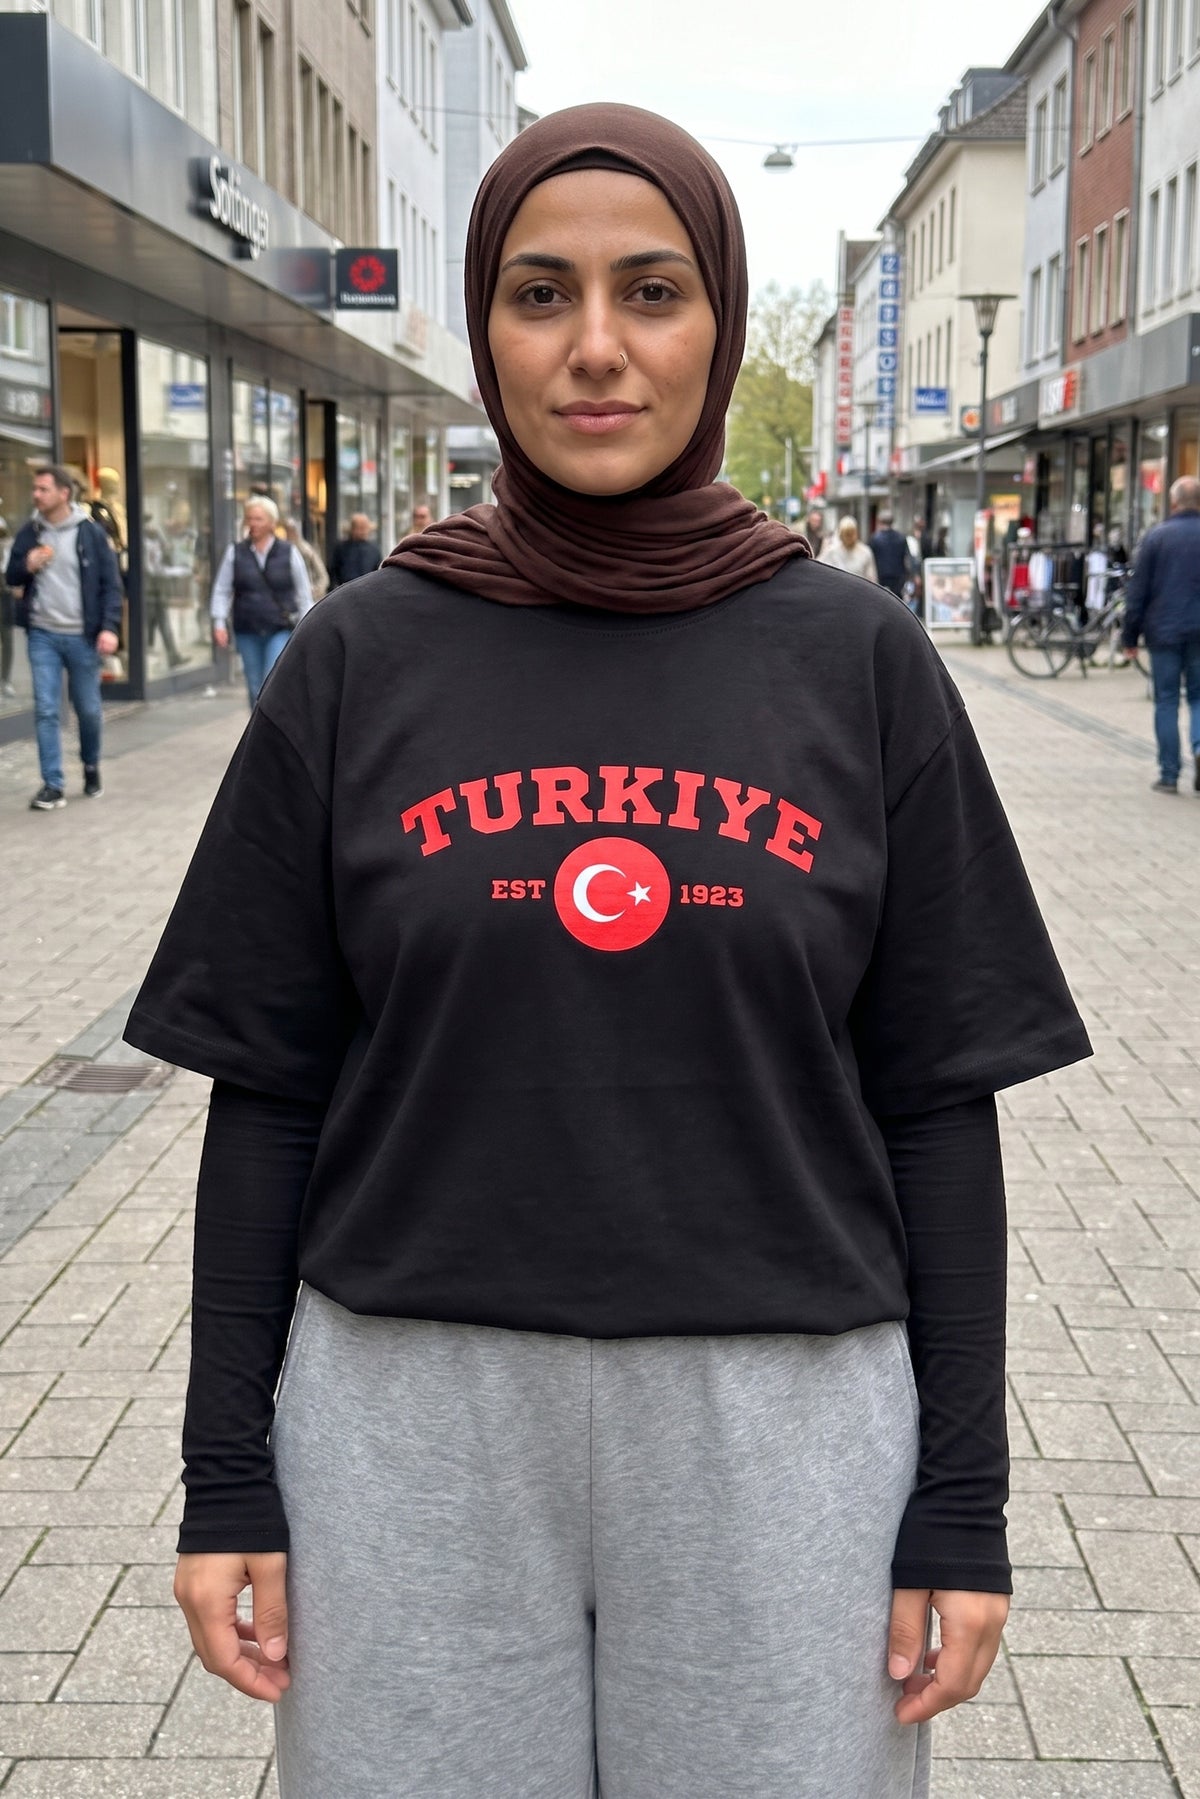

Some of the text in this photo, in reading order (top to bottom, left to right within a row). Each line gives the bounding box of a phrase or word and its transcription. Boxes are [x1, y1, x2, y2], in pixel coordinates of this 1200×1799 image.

[401, 766, 822, 872] TURKIYE
[492, 880, 743, 907] EST 1923
